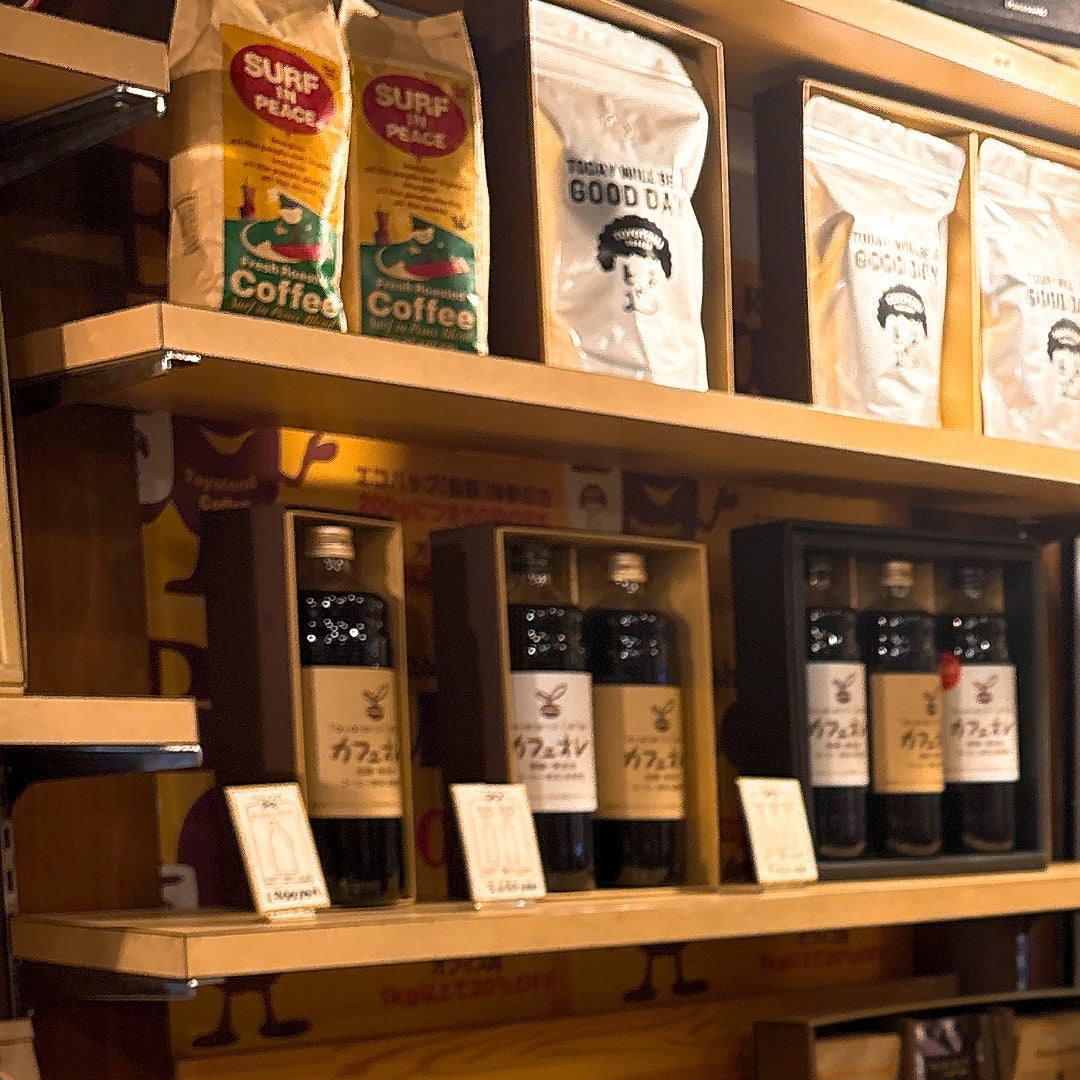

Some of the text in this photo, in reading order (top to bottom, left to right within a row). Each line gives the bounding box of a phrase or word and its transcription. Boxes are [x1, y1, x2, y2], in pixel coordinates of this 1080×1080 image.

[244, 51, 320, 96] SURF
[254, 94, 318, 126] PEACE
[276, 86, 297, 105] IN
[374, 83, 450, 117] SURF
[406, 112, 427, 129] IN
[386, 125, 448, 150] PEACE
[570, 179, 638, 206] GOOD
[229, 268, 341, 317] Coffee
[367, 292, 476, 330] Coffee
